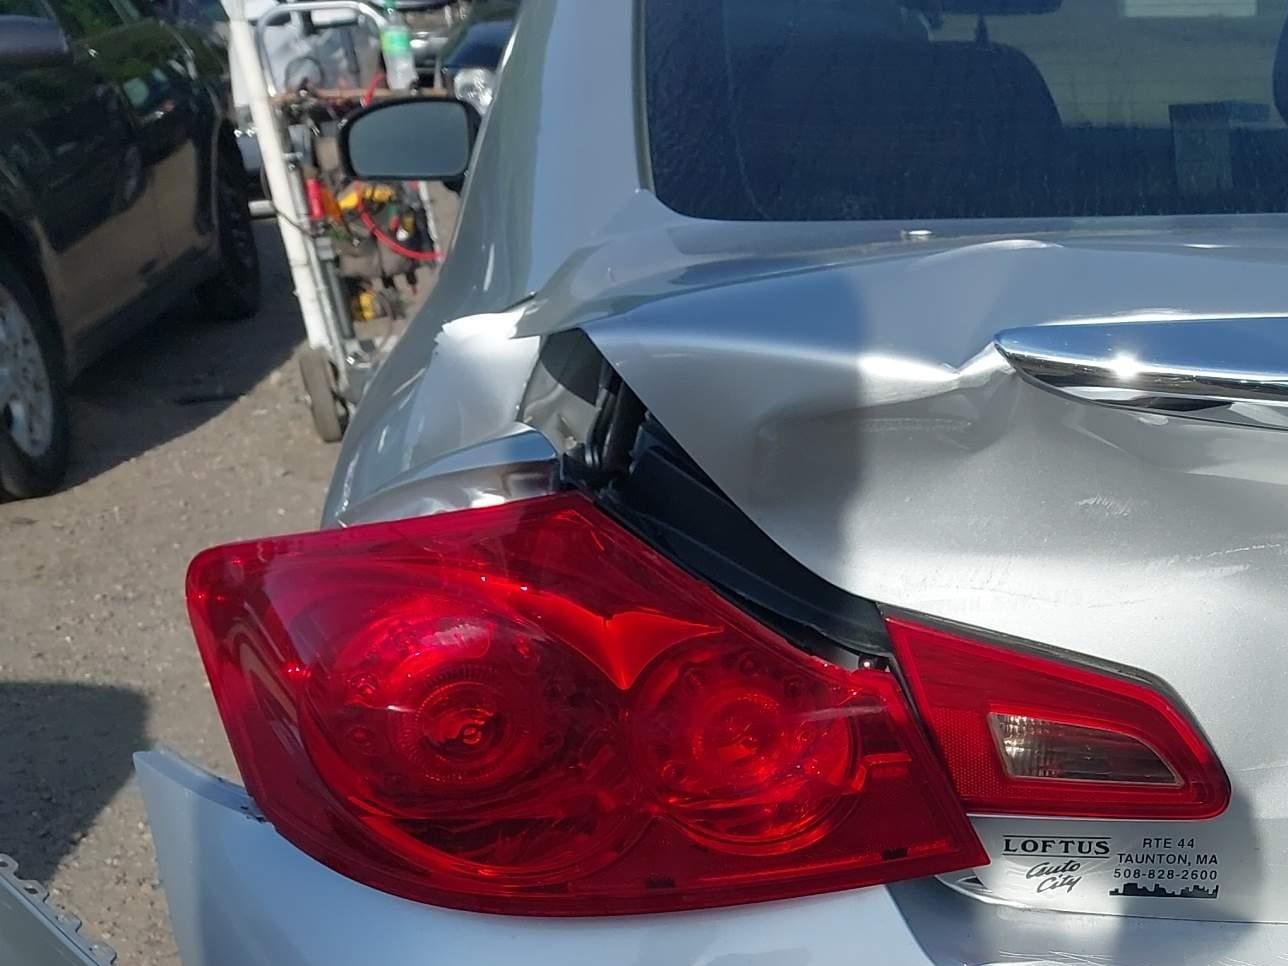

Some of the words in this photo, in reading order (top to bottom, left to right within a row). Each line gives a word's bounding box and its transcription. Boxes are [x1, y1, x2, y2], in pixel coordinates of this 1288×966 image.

[1004, 838, 1110, 856] LOFTUS
[1143, 838, 1172, 848] RTE
[1178, 838, 1194, 848] 44
[1118, 853, 1191, 866] TAUNTON,
[1196, 854, 1218, 865] MA
[1113, 869, 1218, 880] 508-828-2600
[1037, 874, 1082, 893] City
